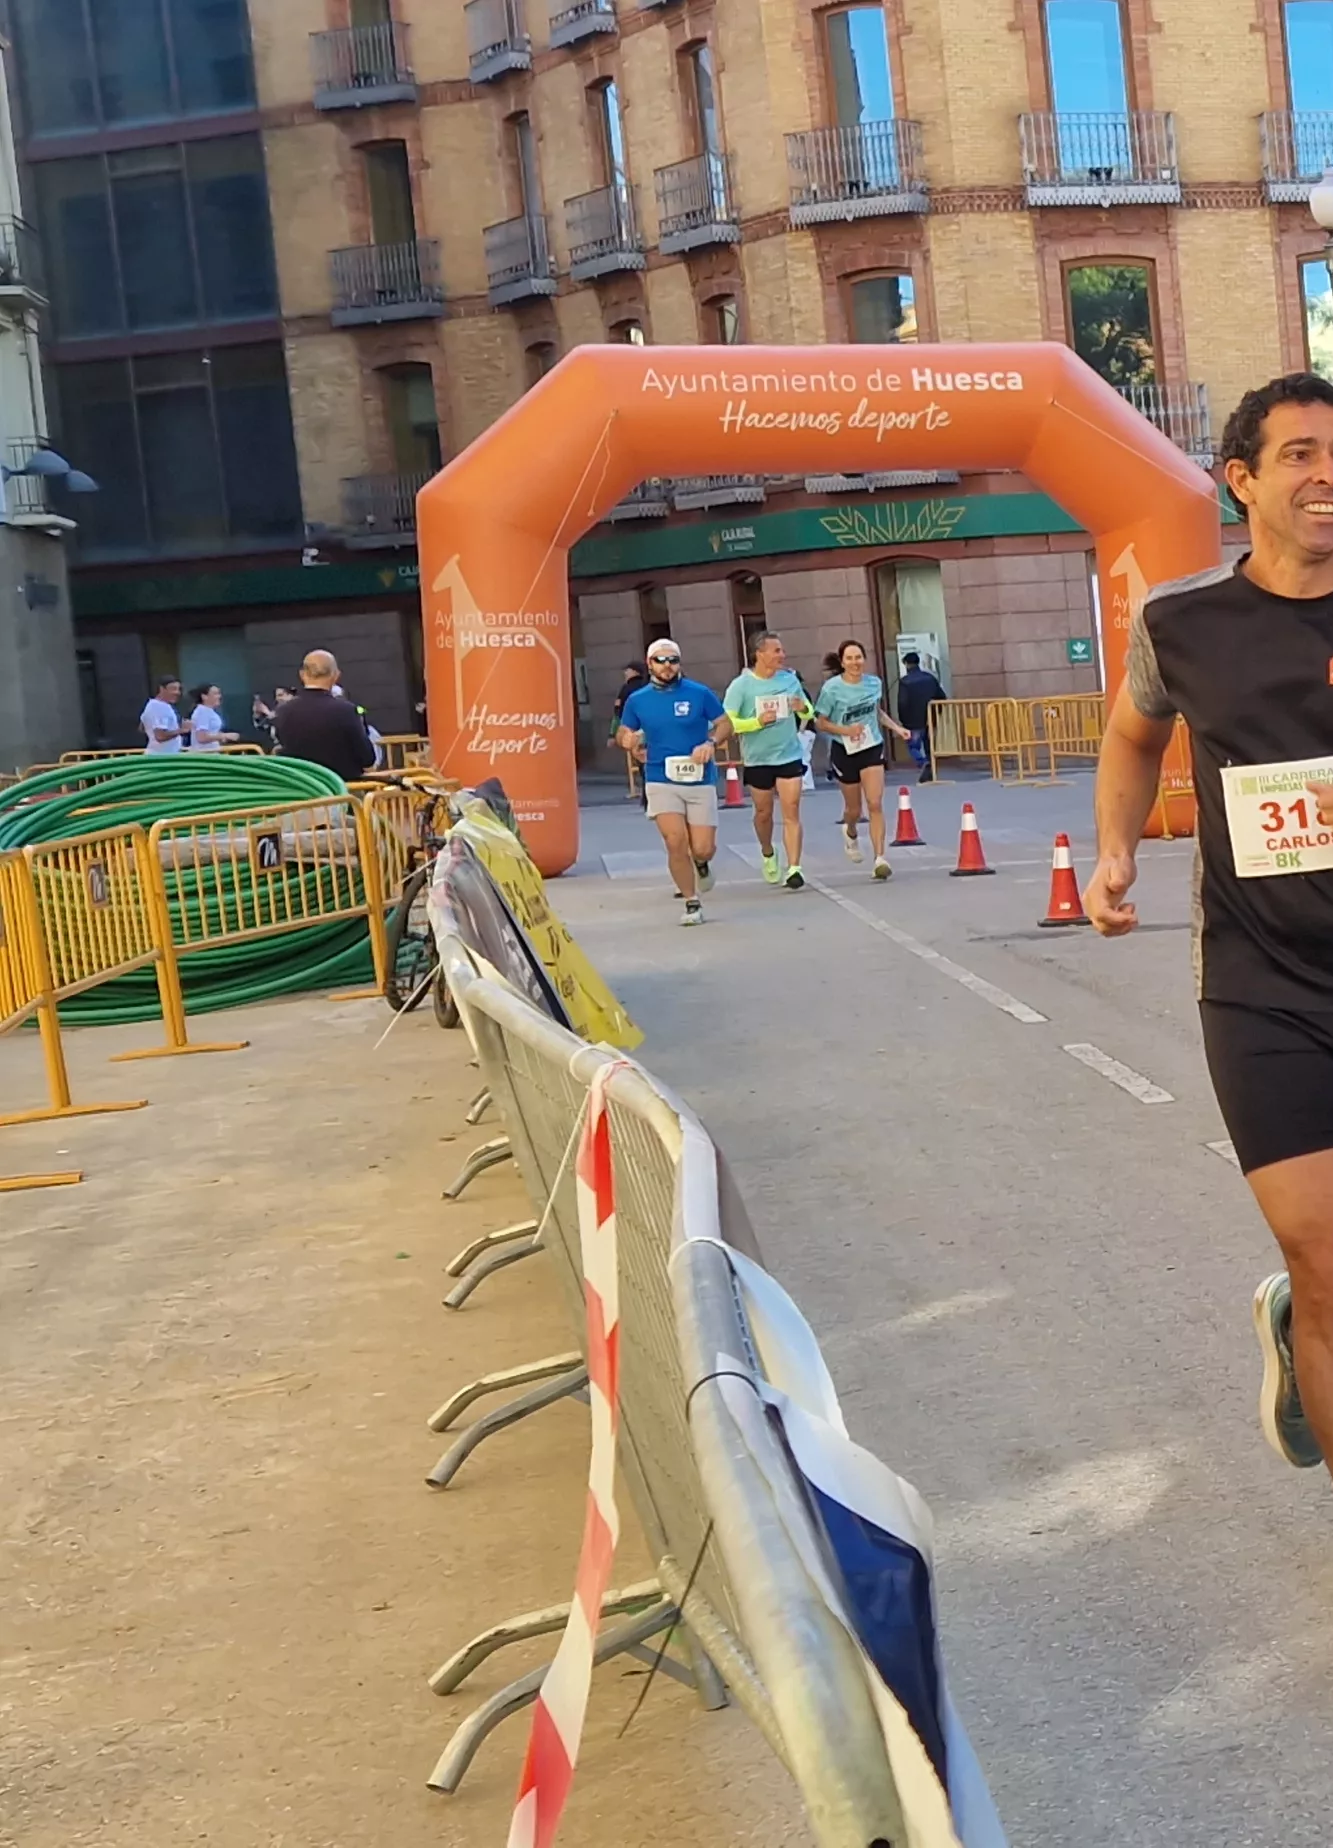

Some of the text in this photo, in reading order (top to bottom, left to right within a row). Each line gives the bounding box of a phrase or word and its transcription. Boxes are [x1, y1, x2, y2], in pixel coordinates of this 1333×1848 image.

[641, 367, 1023, 400] Ayuntamiento de Huesca
[719, 397, 953, 442] Hacemos deporte
[434, 609, 559, 630] Ayuntamiento
[436, 630, 536, 648] de Huesca
[465, 703, 558, 731] Hacemos
[466, 727, 548, 766] deporte
[514, 812, 545, 822] esca
[1275, 851, 1303, 869] 8K
